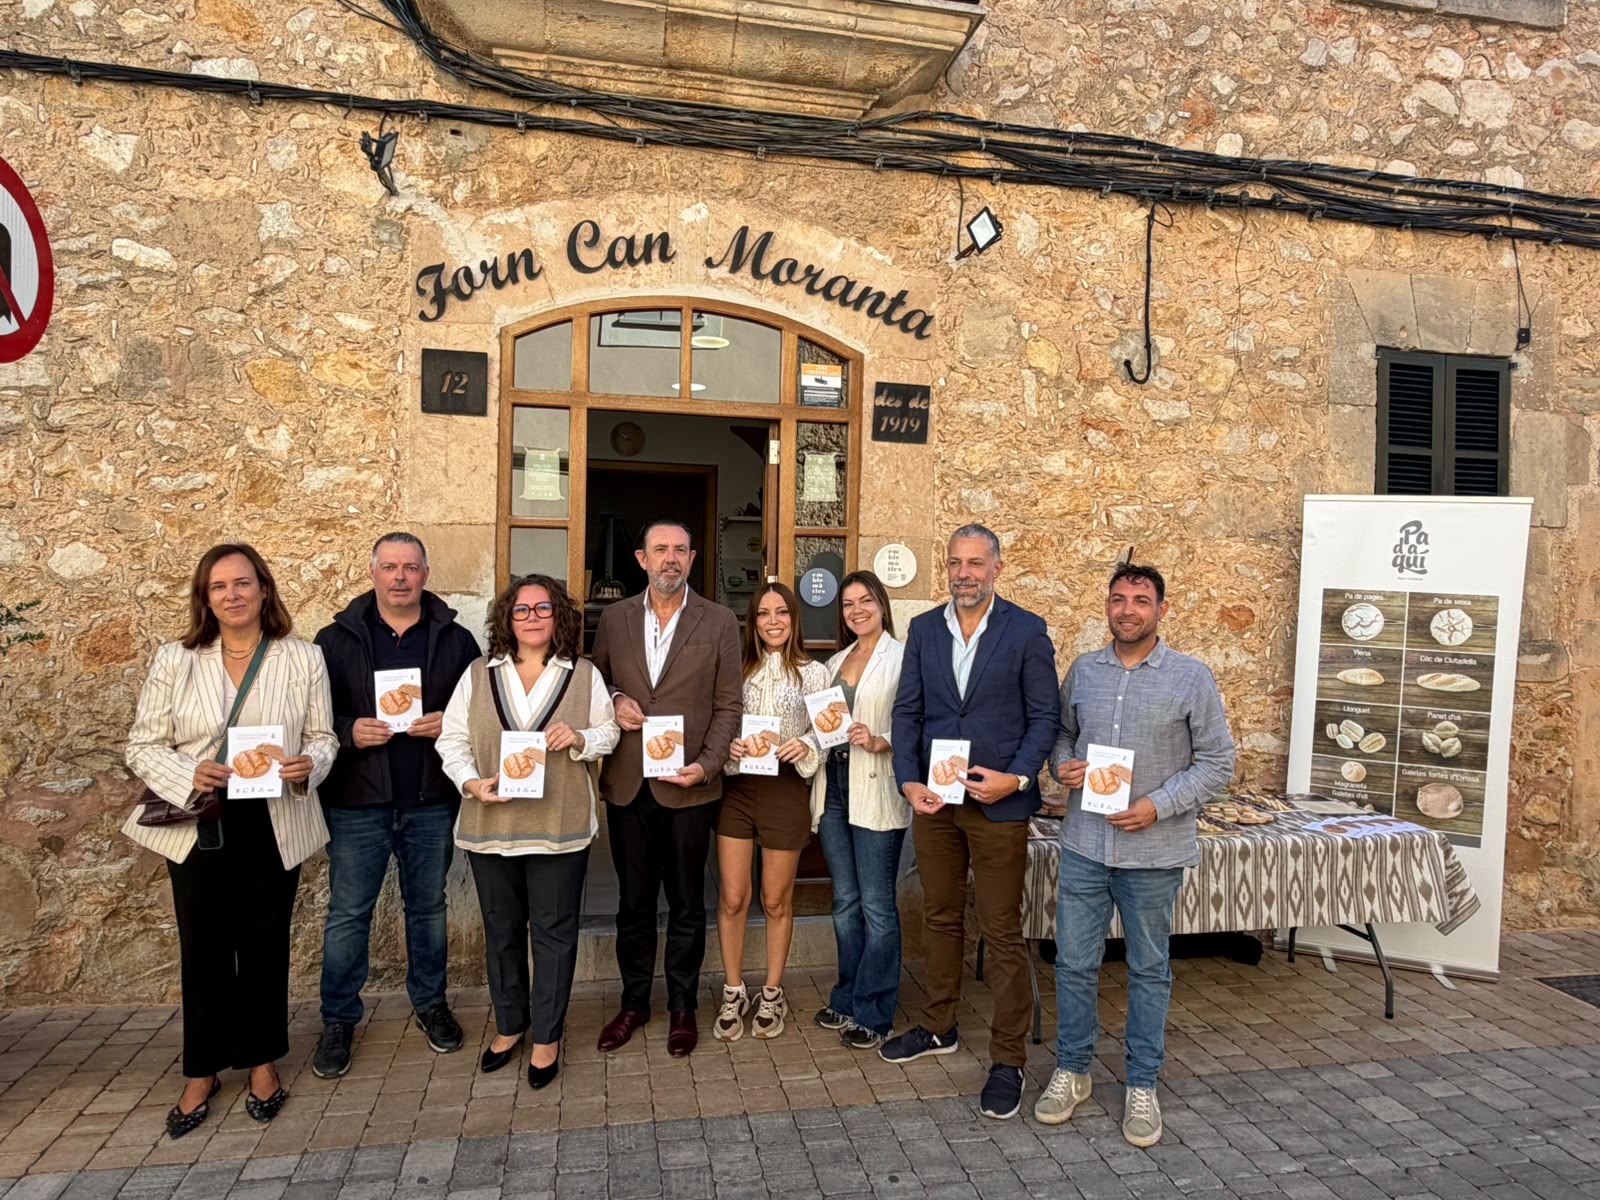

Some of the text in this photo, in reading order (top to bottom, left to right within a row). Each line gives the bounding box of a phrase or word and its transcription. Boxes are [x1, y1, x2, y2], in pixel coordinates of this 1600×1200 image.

[416, 219, 937, 341] Forn Can Moranta
[440, 372, 470, 395] 12
[908, 391, 929, 410] de
[880, 415, 921, 433] 1919
[1433, 597, 1442, 605] Pa
[1433, 656, 1443, 664] de
[1343, 705, 1371, 715] Llonguet
[1427, 711, 1447, 720] Panet
[1401, 768, 1427, 778] Galetes
[1428, 771, 1449, 780] fortes
[1331, 789, 1355, 799] Galetes
